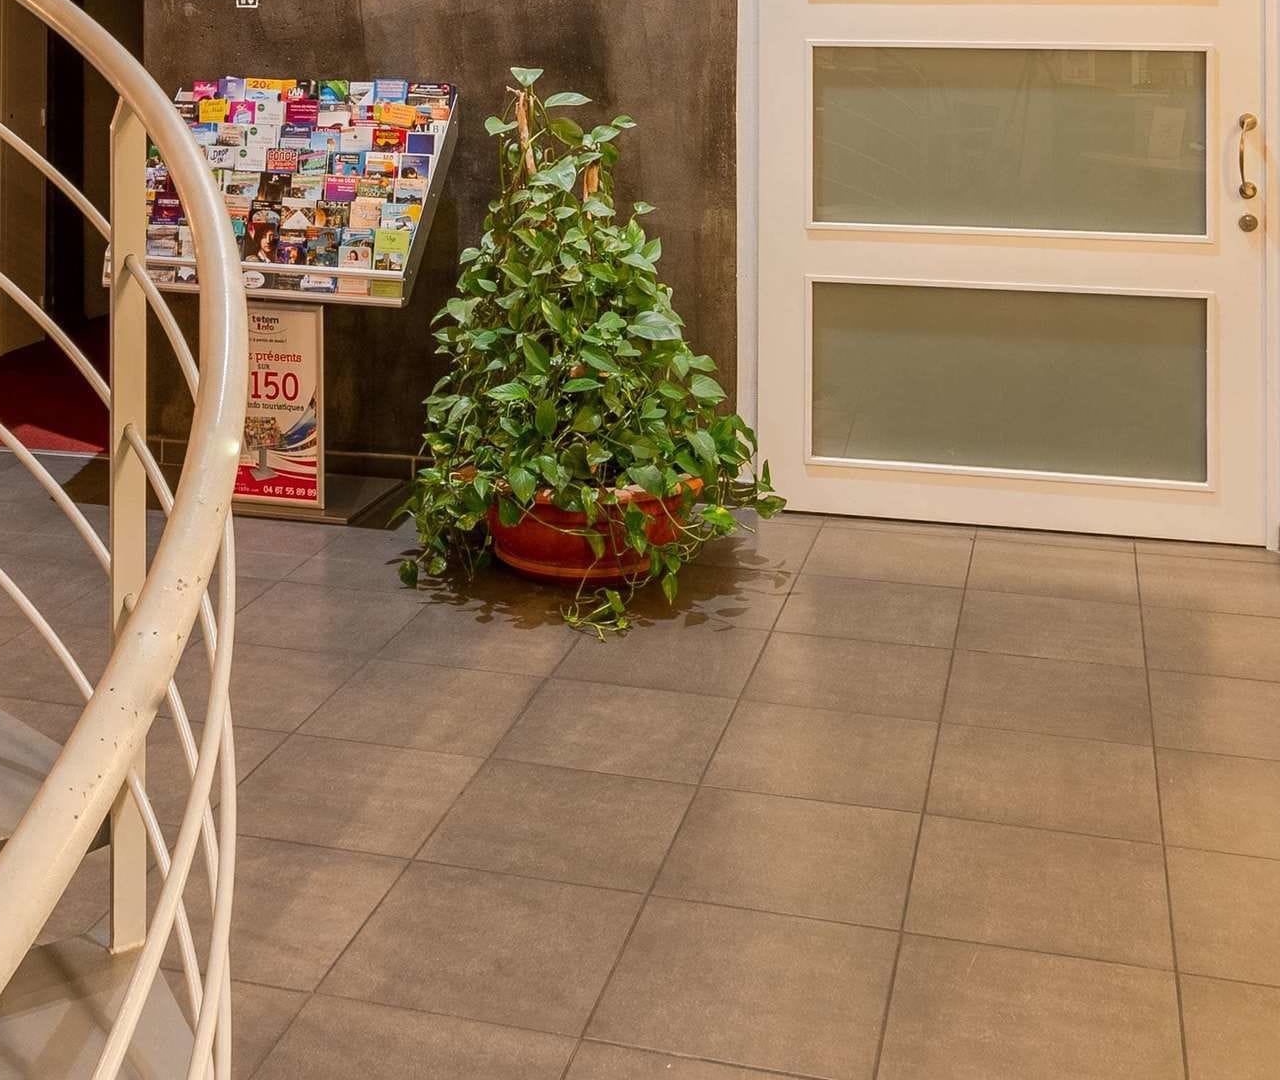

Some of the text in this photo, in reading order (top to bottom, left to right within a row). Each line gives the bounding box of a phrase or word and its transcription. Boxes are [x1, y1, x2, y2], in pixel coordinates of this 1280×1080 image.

[255, 350, 302, 363] présents
[251, 371, 299, 401] 150
[263, 485, 273, 494] 04
